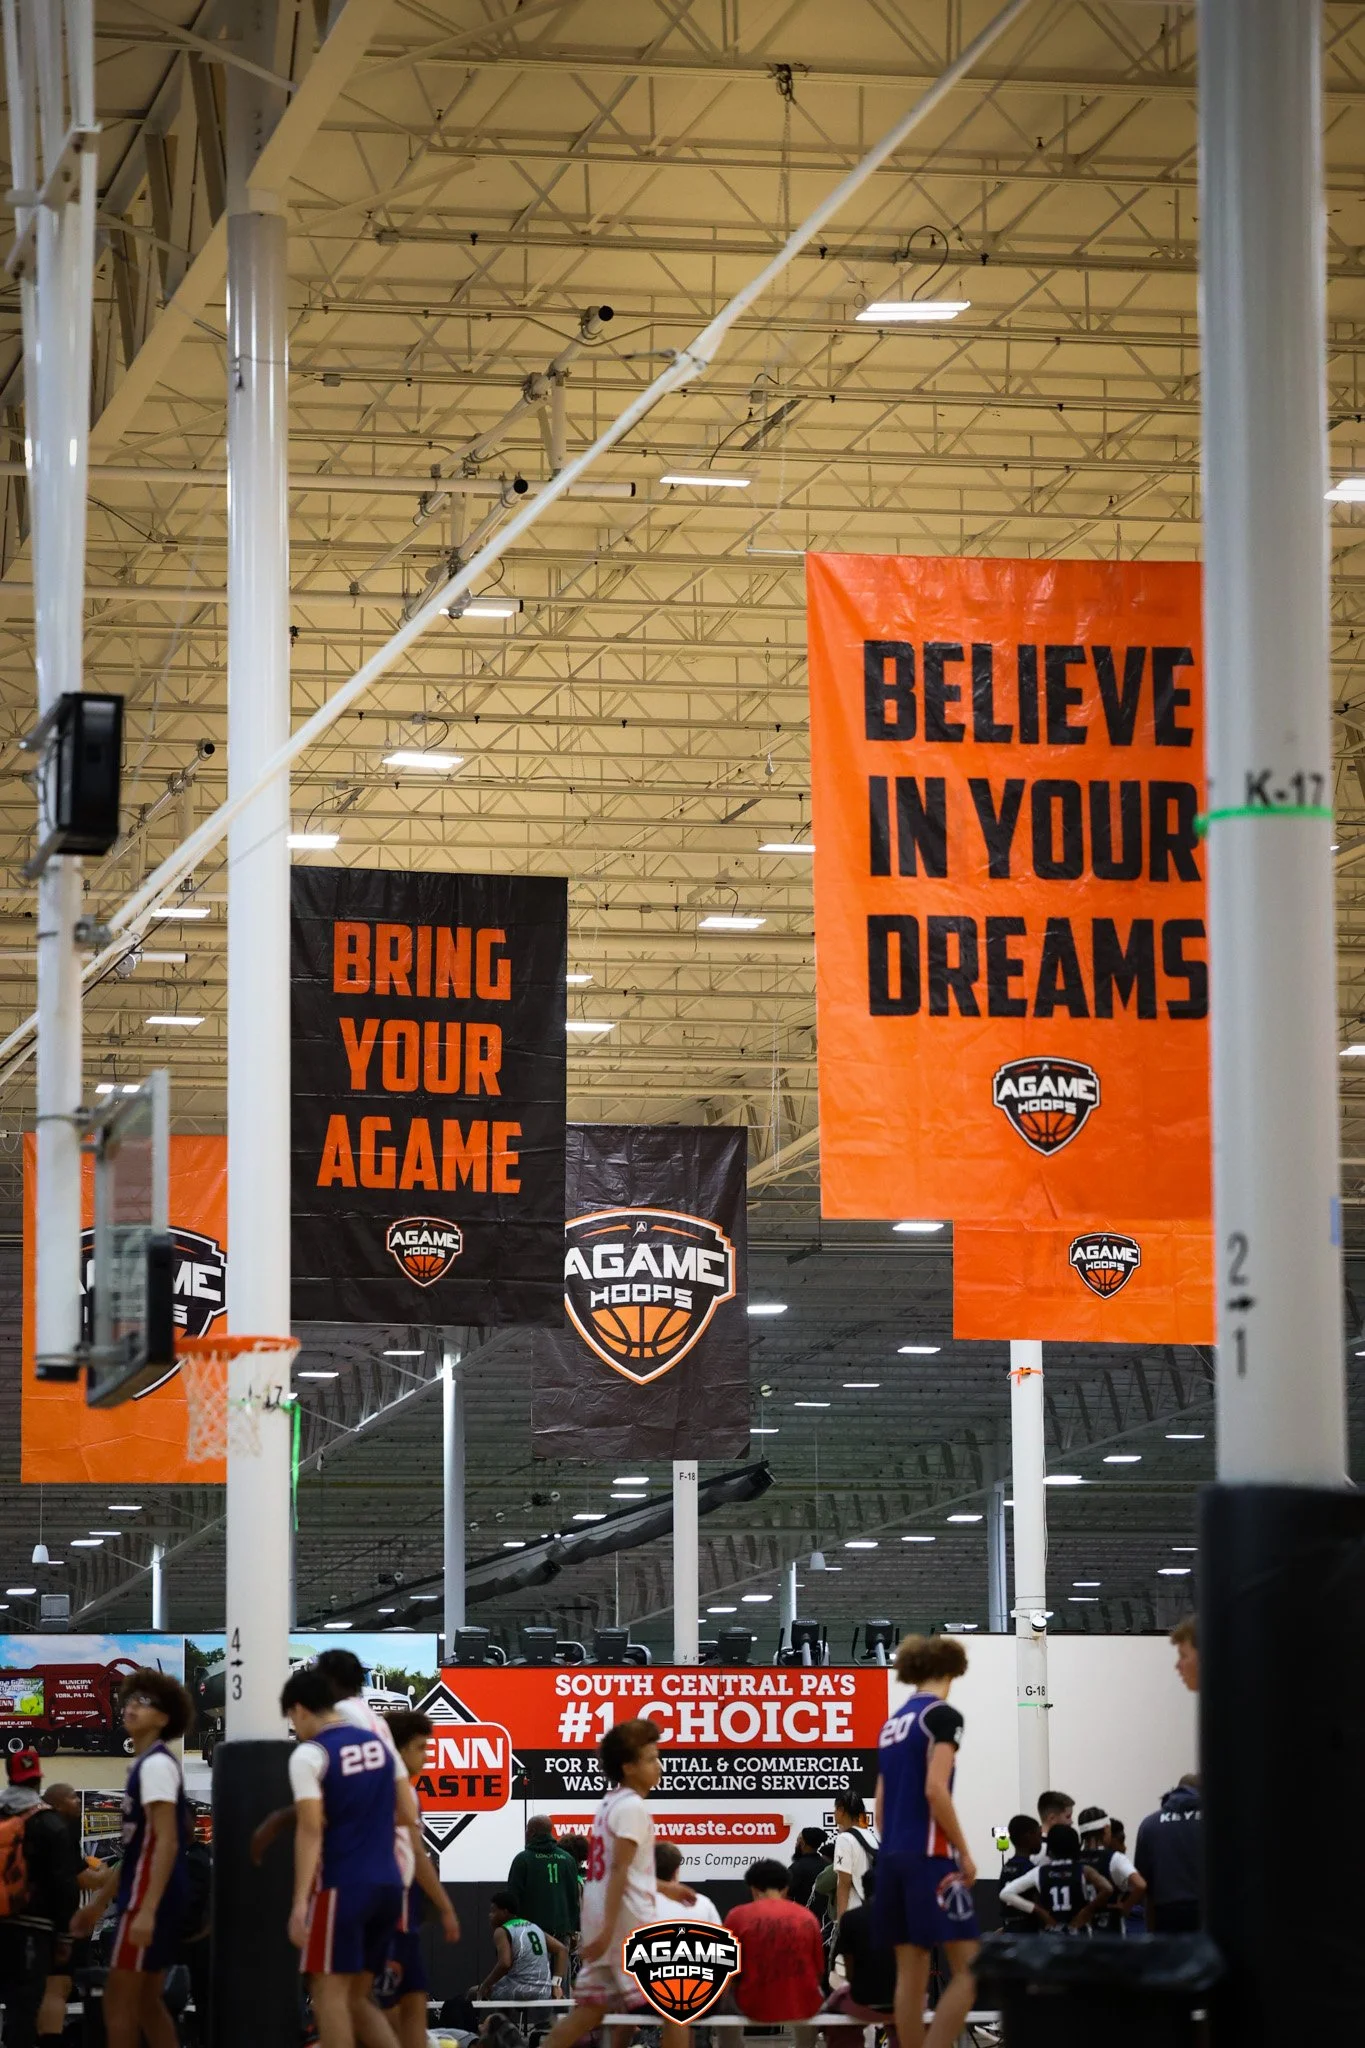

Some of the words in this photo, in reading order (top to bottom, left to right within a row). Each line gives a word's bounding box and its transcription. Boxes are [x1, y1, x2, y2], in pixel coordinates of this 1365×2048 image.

[863, 639, 1194, 747] BELIEVE
[1245, 767, 1324, 807] K-17
[869, 775, 947, 879] IN
[968, 777, 1201, 881] YOUR
[333, 921, 512, 1001] BRING
[867, 914, 1210, 1020] DREAMS
[339, 1017, 502, 1096] YOUR
[998, 1076, 1097, 1102] AGAME
[1017, 1100, 1077, 1115] HOOPS
[316, 1114, 522, 1194] AGAME
[391, 1230, 459, 1250] AGAME
[404, 1247, 446, 1258] HOOPS
[565, 1243, 726, 1287] AGAME
[1071, 1245, 1138, 1263] AGAME
[1085, 1261, 1125, 1272] HOOPS
[1228, 1231, 1249, 1286] 2
[590, 1286, 693, 1310] HOOPS
[1234, 1325, 1248, 1378] 1
[679, 1472, 696, 1481] F-18
[231, 1628, 241, 1653] 4
[232, 1674, 242, 1701] 3
[555, 1674, 654, 1696] SOUTH
[661, 1674, 794, 1696] CENTRAL
[800, 1674, 856, 1696] PA'S
[1025, 1685, 1046, 1696] G-18
[558, 1701, 614, 1743] #1
[636, 1701, 854, 1743] CHOICE
[879, 1712, 917, 1748] 20
[339, 1739, 387, 1776] 29
[422, 1737, 504, 1769] ENN
[545, 1758, 582, 1773] FOR
[587, 1757, 713, 1773] RNTIAL
[717, 1757, 730, 1772] &
[734, 1757, 863, 1773] COMMERCIAL
[415, 1774, 502, 1797] ASTE
[563, 1775, 621, 1791] WAST
[761, 1775, 850, 1790] SERVICES
[547, 1863, 558, 1884] 11
[1049, 1885, 1072, 1911] 11
[527, 1931, 543, 1956] 8
